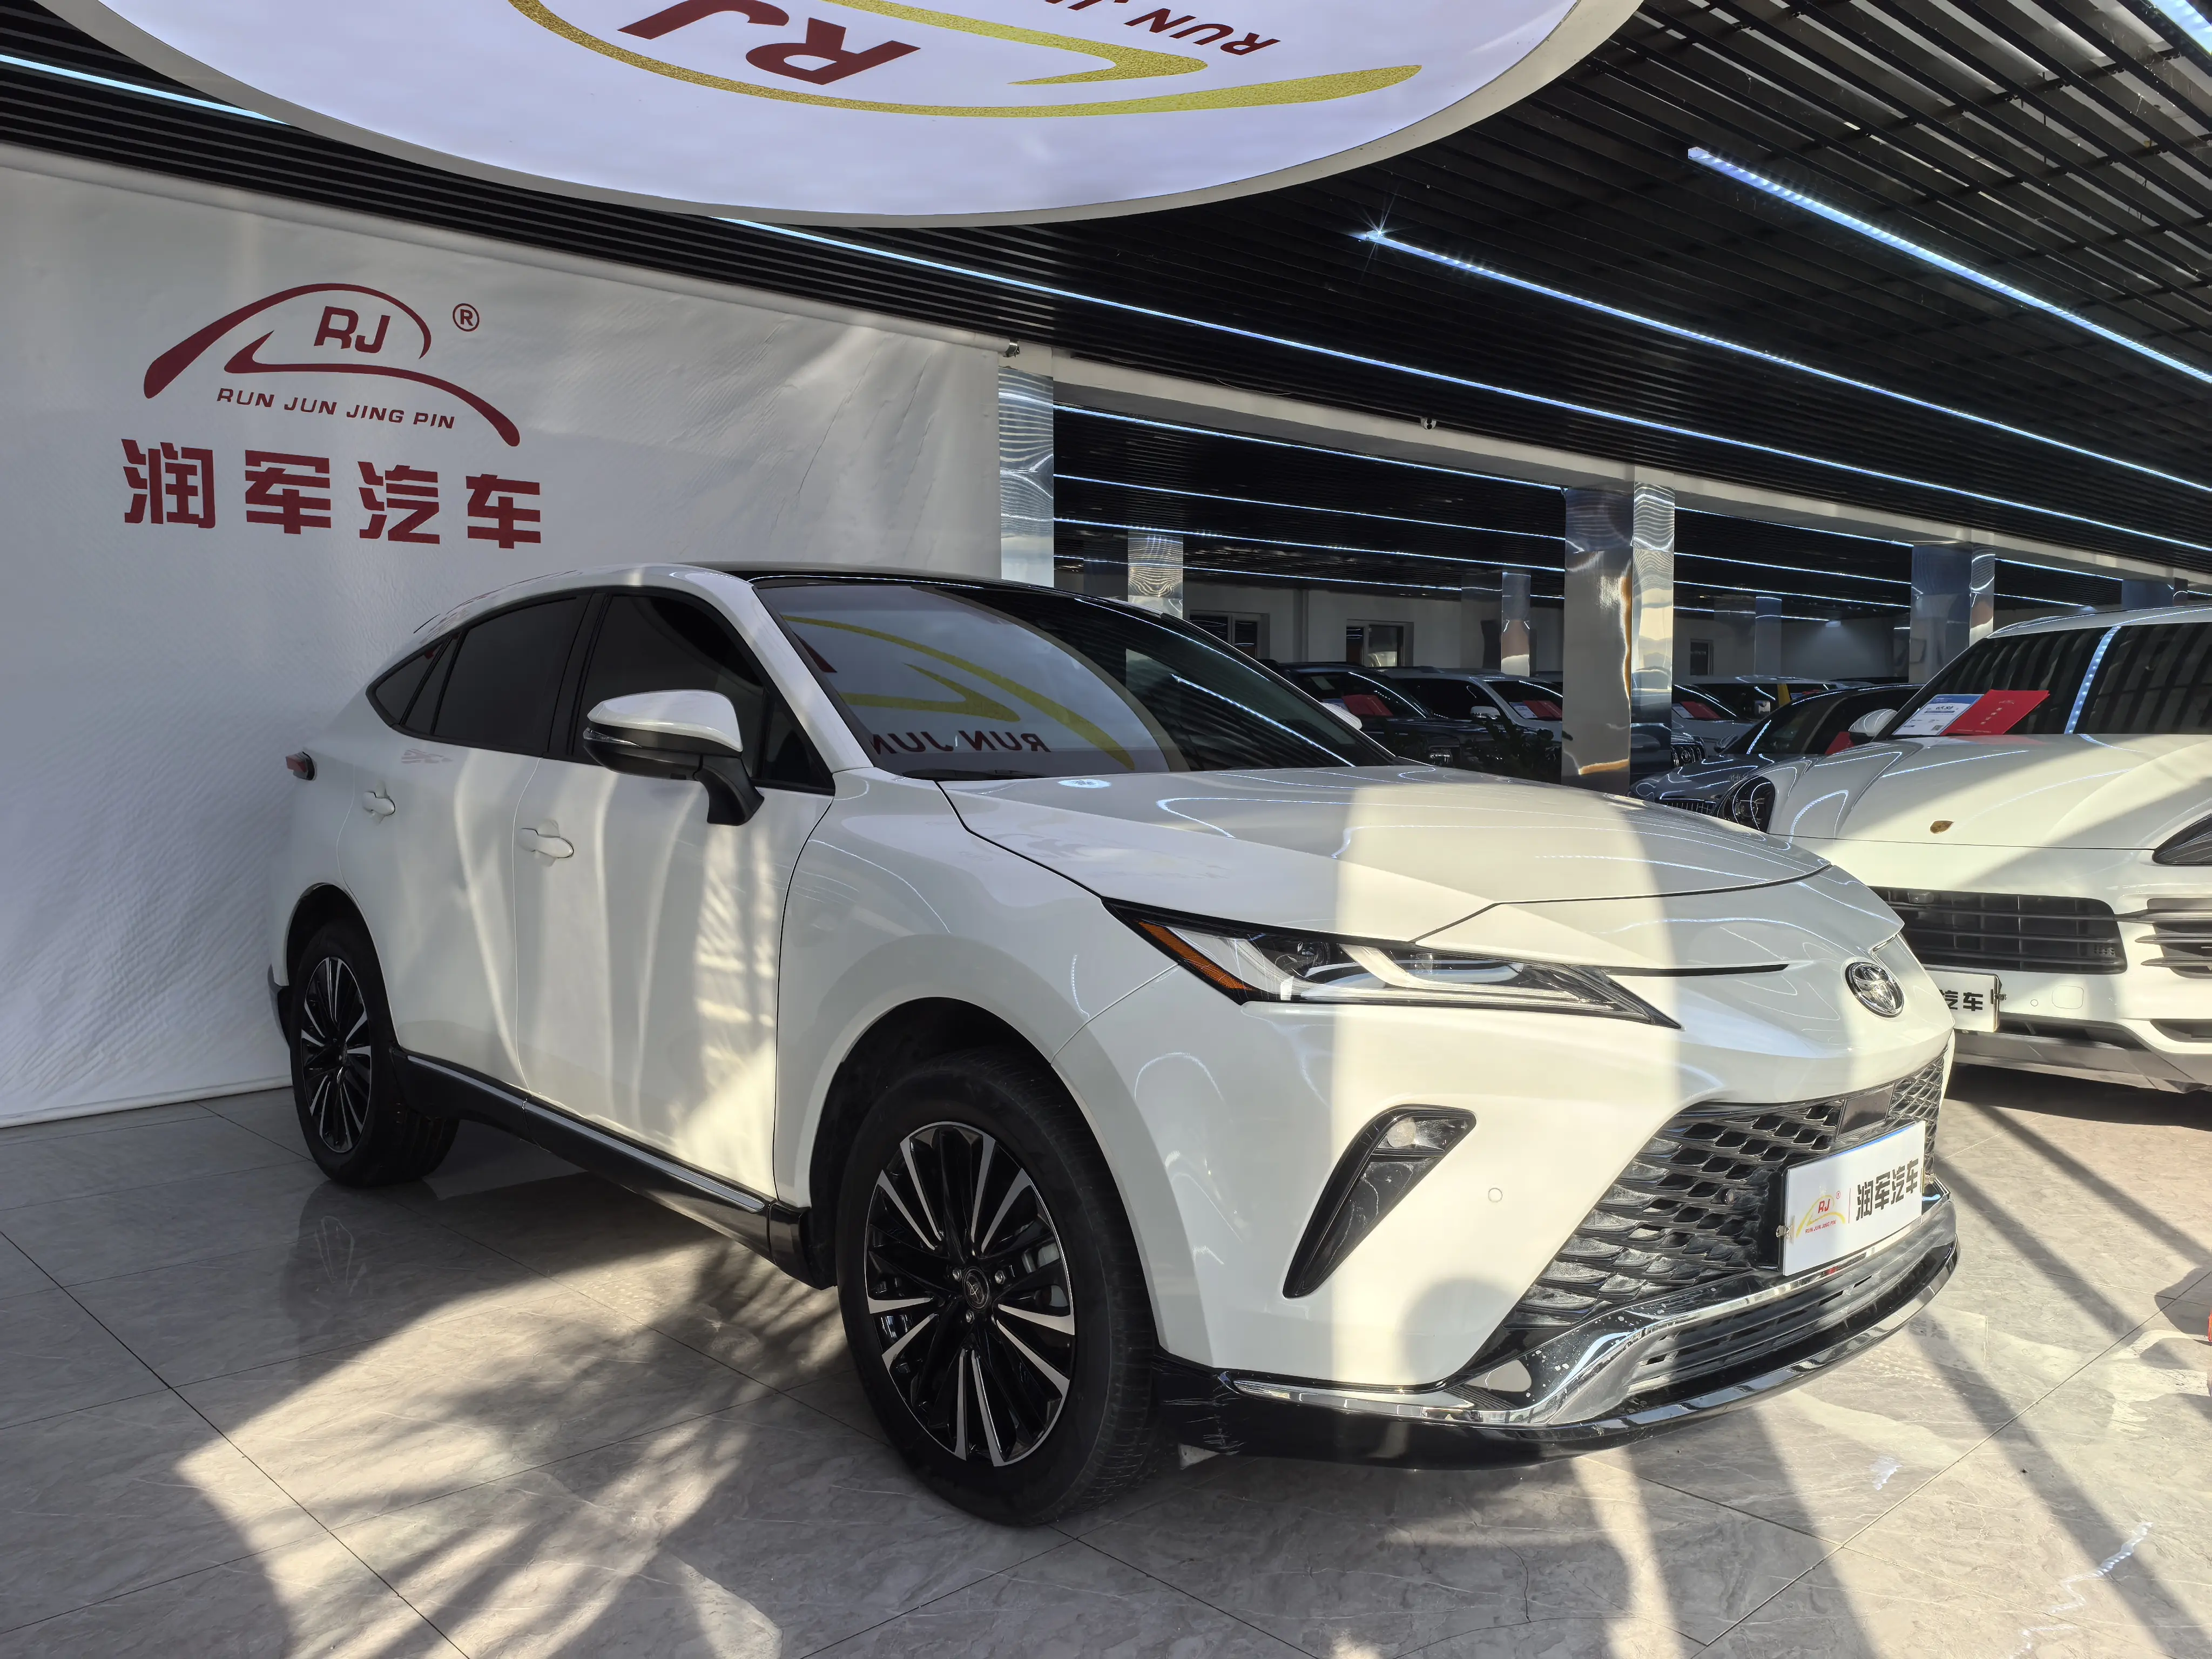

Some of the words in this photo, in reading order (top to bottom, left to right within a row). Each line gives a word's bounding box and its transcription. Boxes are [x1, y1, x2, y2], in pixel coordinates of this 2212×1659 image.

[617, 0, 921, 85] RJ
[1123, 8, 1281, 55] RUN
[314, 306, 391, 354] RJ
[217, 388, 275, 408] RUN
[284, 397, 338, 415] JUN
[346, 405, 404, 423] JING
[414, 412, 455, 429] PIN
[121, 439, 542, 550] 润军汽车
[1818, 1198, 1831, 1213] RJ
[1856, 1158, 1919, 1221] 润军汽车
